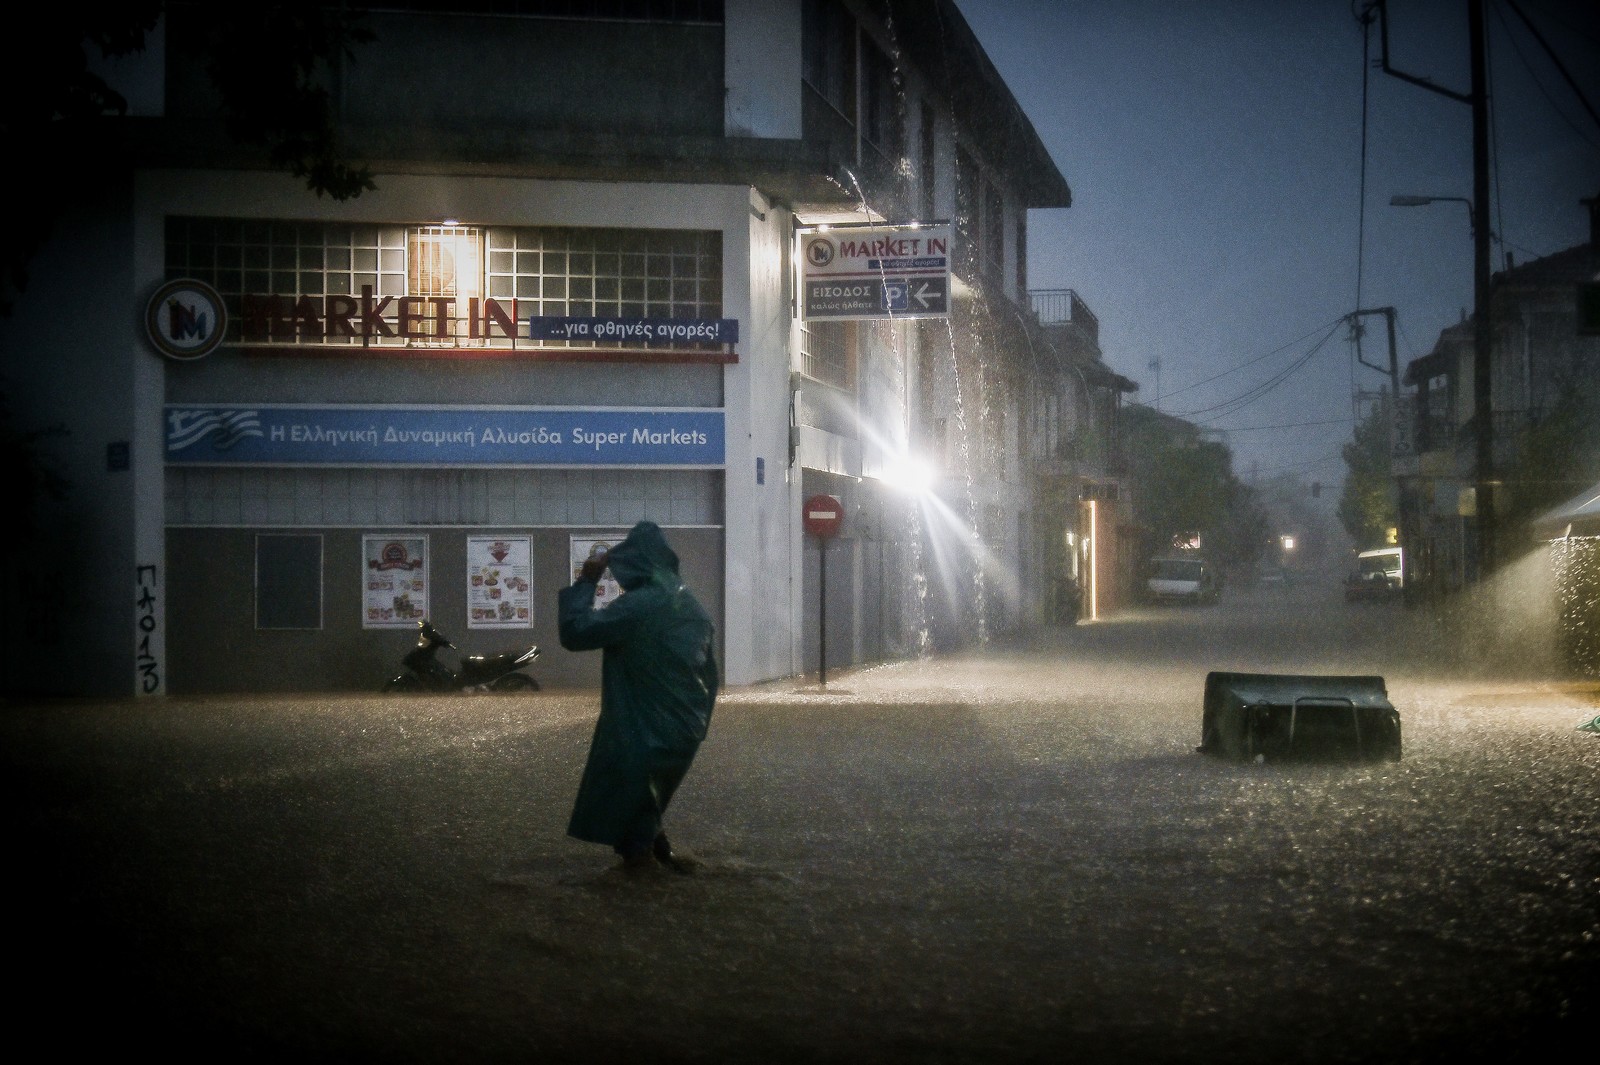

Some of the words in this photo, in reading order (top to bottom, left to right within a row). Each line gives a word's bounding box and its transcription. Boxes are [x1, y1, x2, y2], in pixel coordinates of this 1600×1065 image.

[840, 235, 920, 258] MARKET
[927, 238, 946, 255] IN
[813, 286, 871, 298] ΕΙΣΟΔΟΣ
[887, 287, 901, 302] P
[243, 284, 455, 340] MARKET
[468, 296, 518, 340] IN
[811, 301, 840, 310] καλώς
[550, 322, 589, 338] ...για
[594, 321, 653, 338] φθηνές
[657, 321, 720, 340] αγορές!
[291, 424, 377, 447] Ελληνική
[384, 425, 475, 447] Δυναμική
[481, 426, 562, 445] Αλυσίδα
[572, 427, 630, 451] Super
[632, 428, 707, 445] Markets
